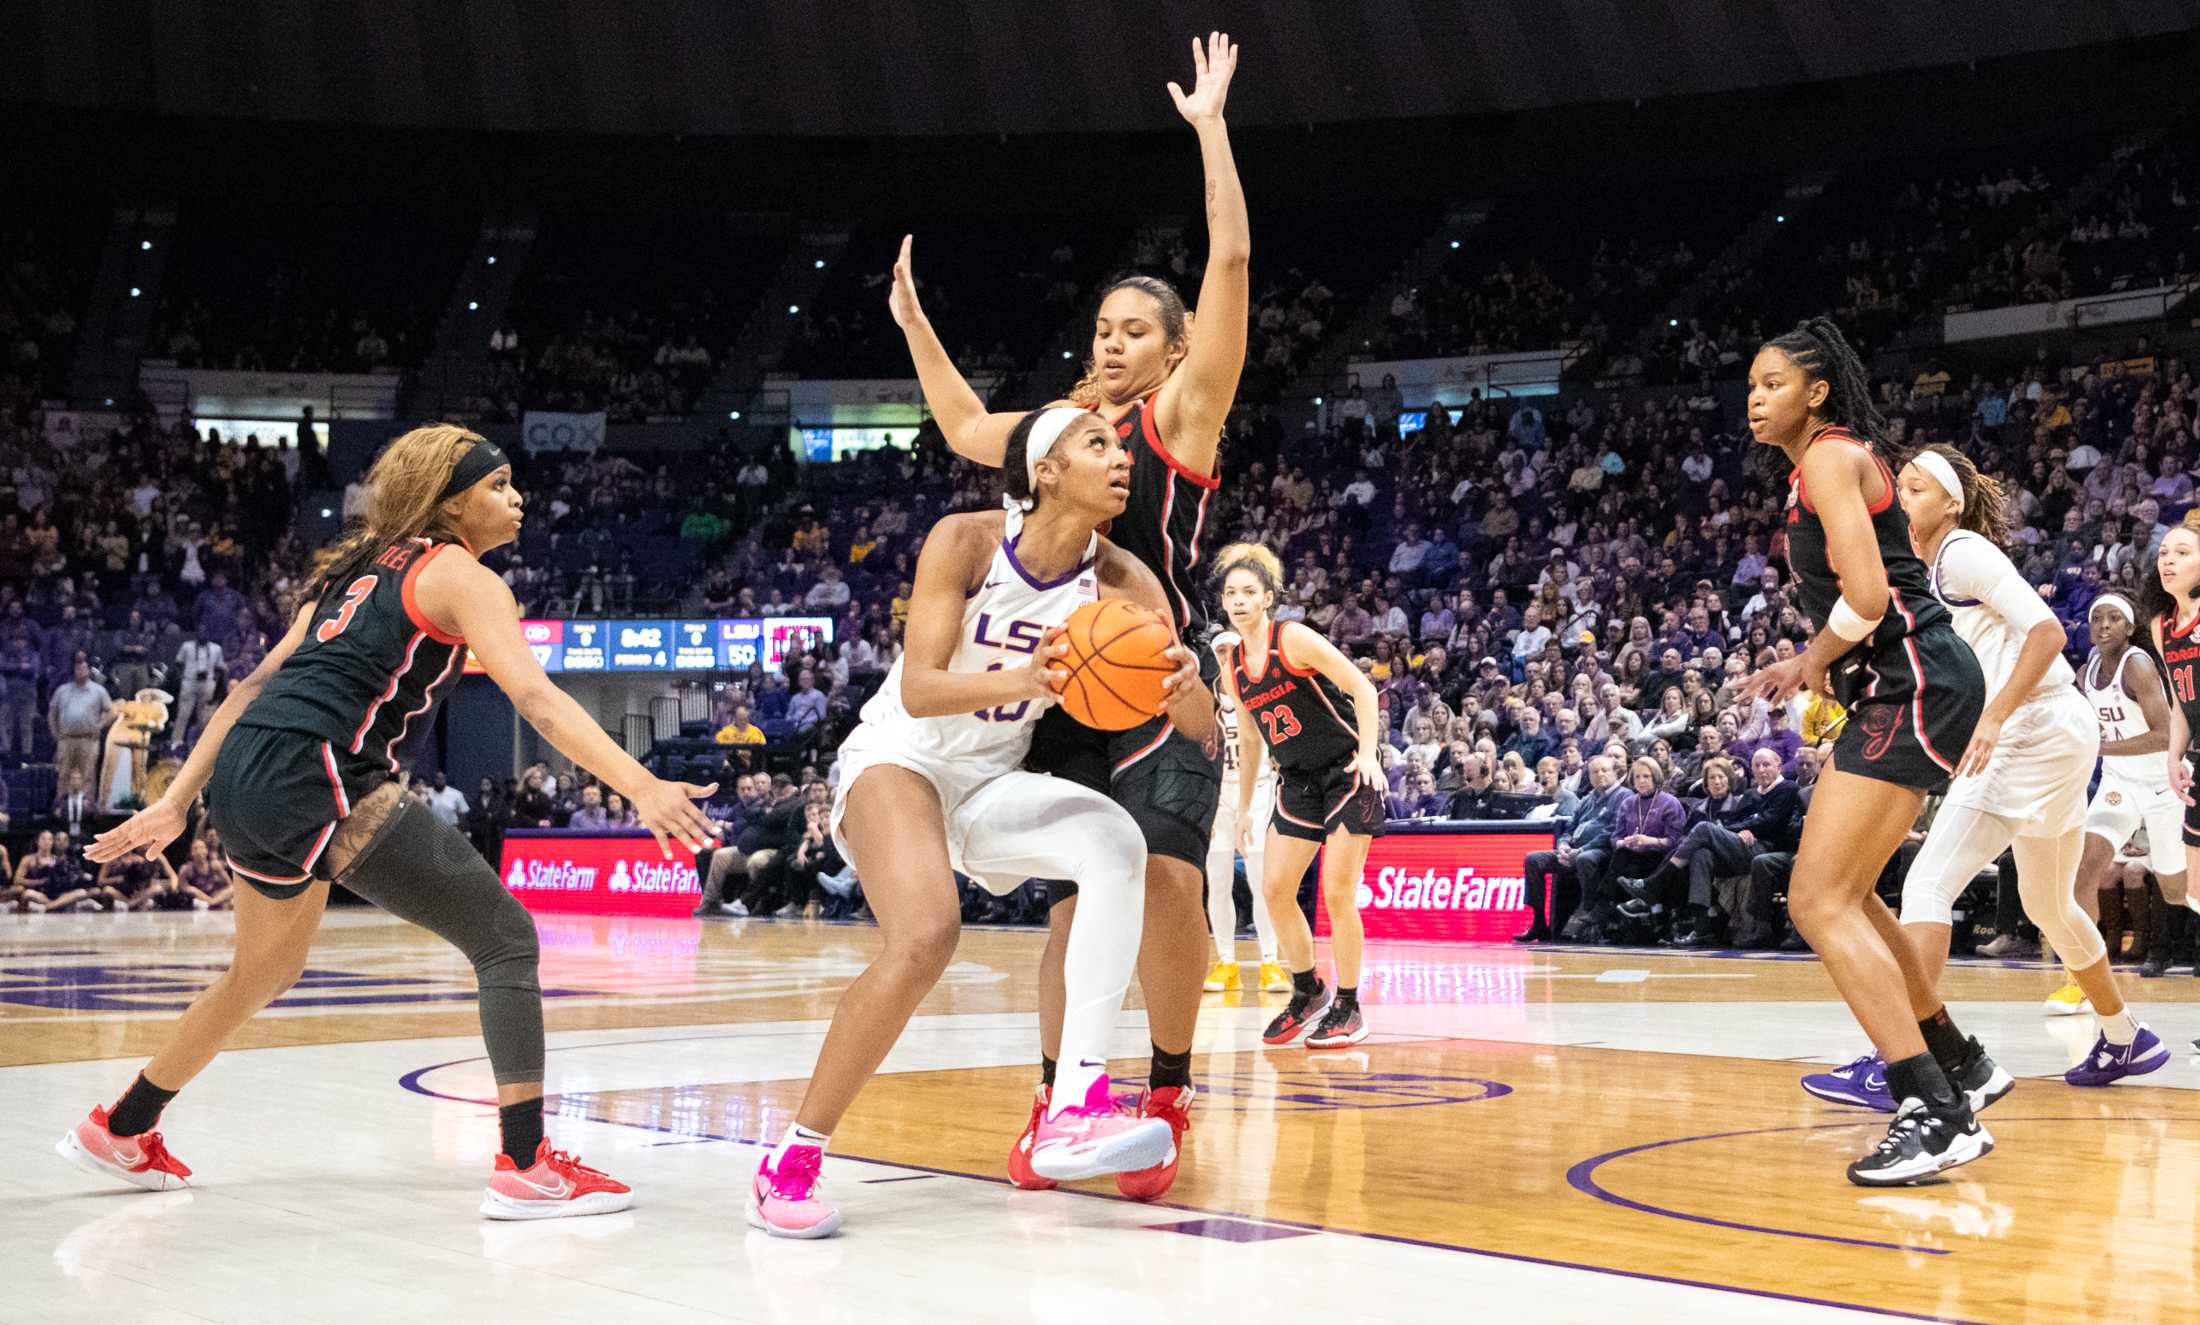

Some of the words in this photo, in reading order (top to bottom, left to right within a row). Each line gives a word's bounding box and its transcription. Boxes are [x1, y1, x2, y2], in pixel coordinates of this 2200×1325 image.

[317, 574, 378, 643] 3
[723, 624, 760, 640] LSU
[973, 612, 1059, 654] LS
[728, 644, 756, 665] 50
[2173, 664, 2196, 703] 31
[1260, 704, 1303, 745] 23
[2099, 706, 2125, 722] SU
